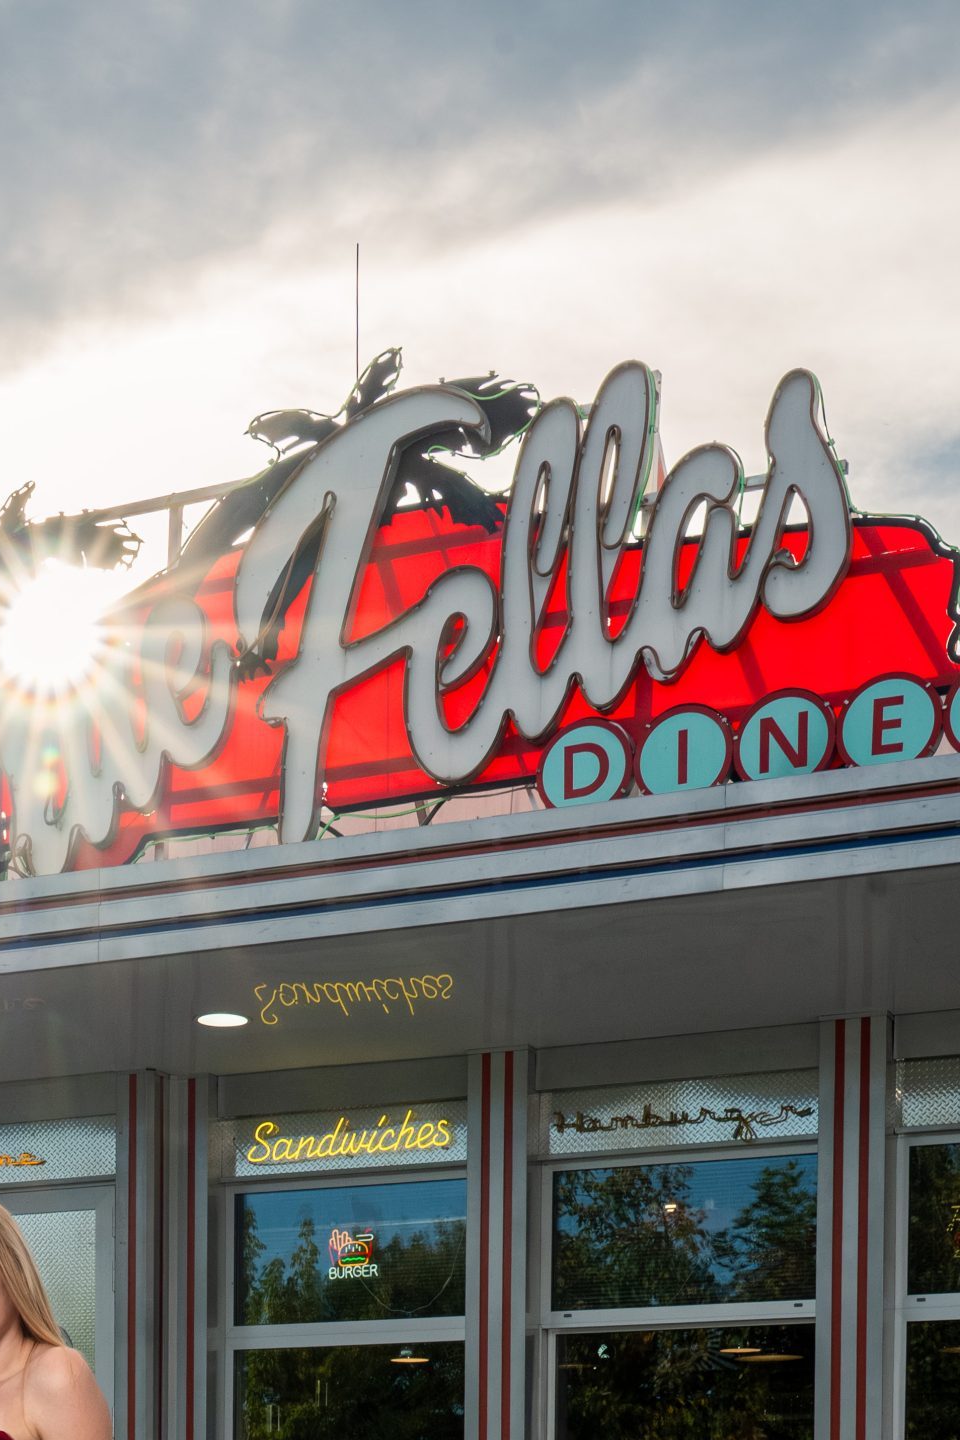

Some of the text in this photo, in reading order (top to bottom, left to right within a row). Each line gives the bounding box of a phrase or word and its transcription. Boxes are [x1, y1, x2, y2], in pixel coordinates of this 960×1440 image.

[233, 360, 851, 843] Fellas
[563, 695, 905, 800] DINE
[247, 1109, 451, 1163] Sandwiches
[328, 1264, 379, 1280] BURGER
